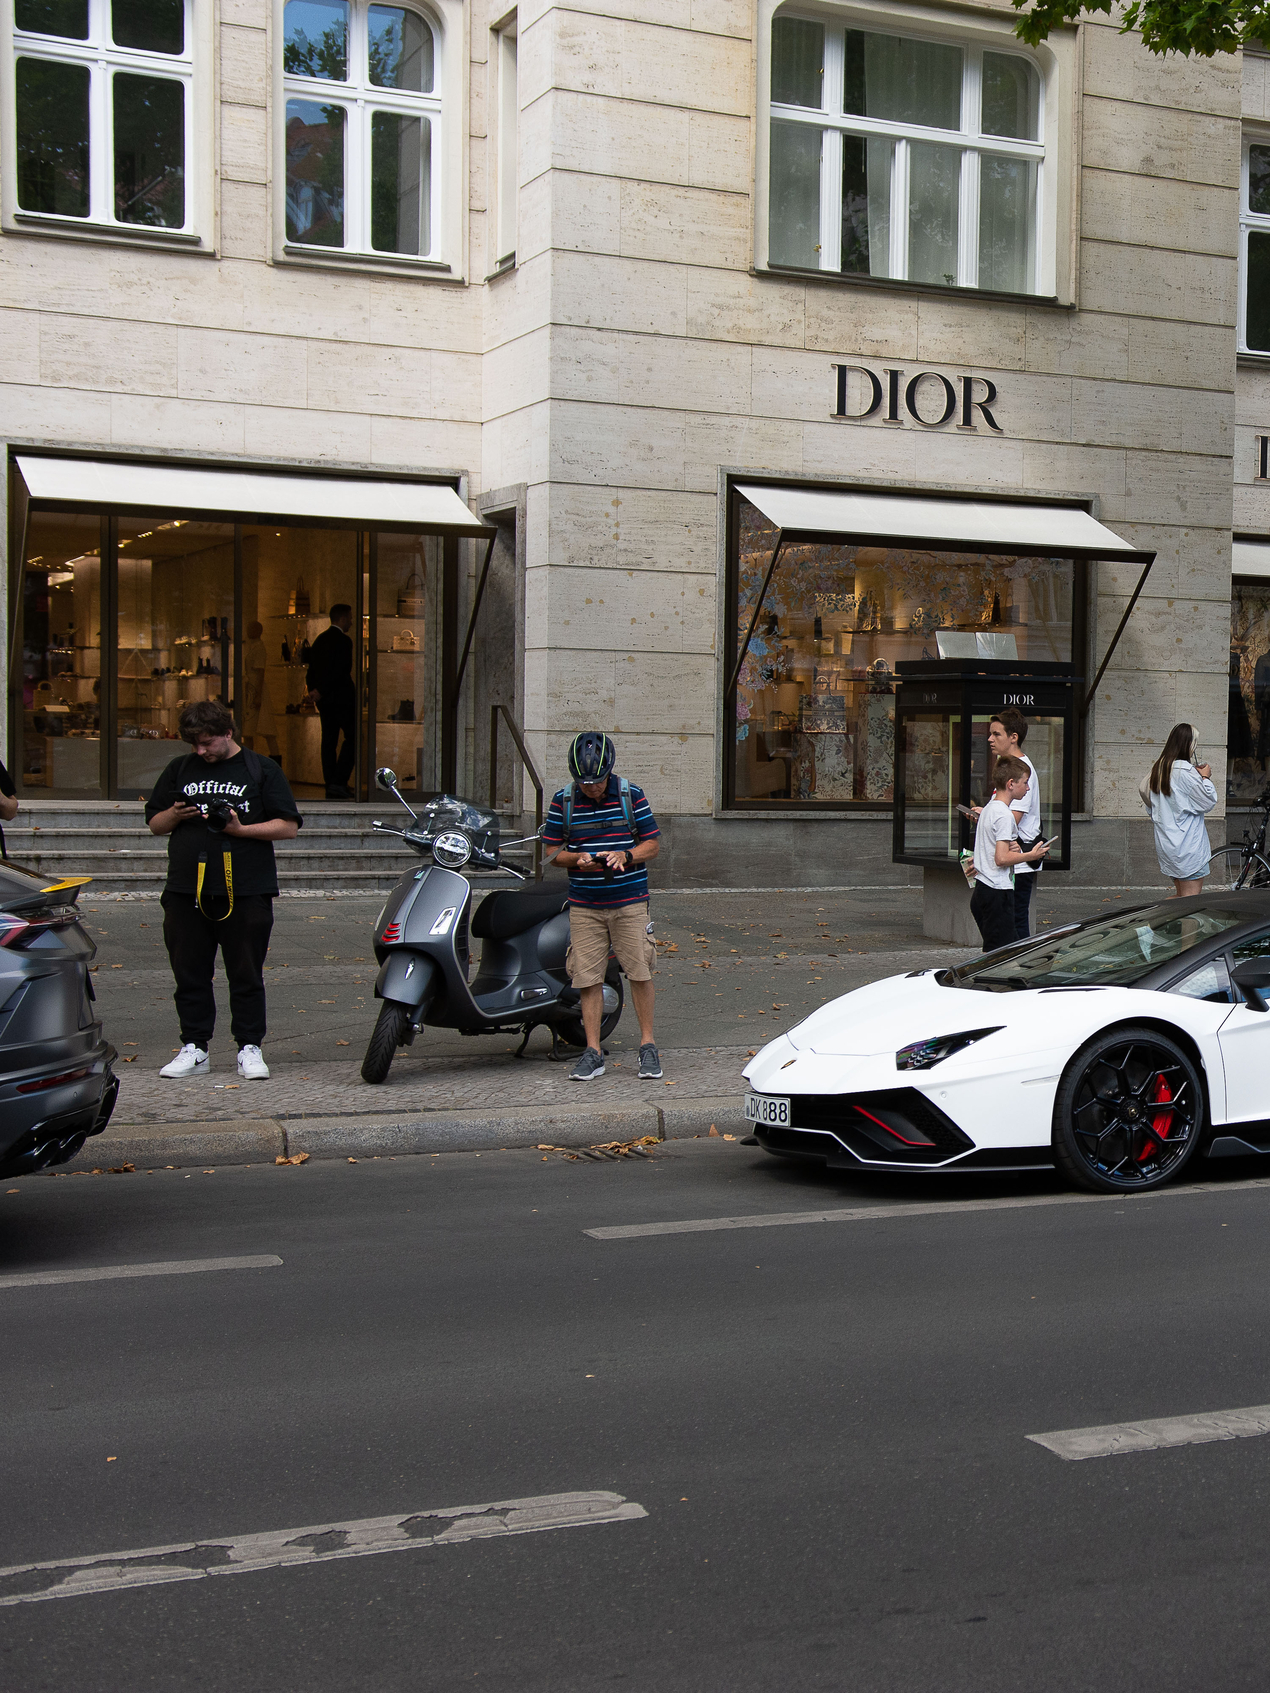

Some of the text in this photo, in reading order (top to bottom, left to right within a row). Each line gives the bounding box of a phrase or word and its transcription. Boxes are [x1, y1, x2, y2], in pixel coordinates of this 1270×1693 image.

[830, 363, 1004, 432] DIOR
[1003, 693, 1035, 706] DIOR
[183, 779, 248, 797] Official
[762, 1100, 788, 1123] 888
